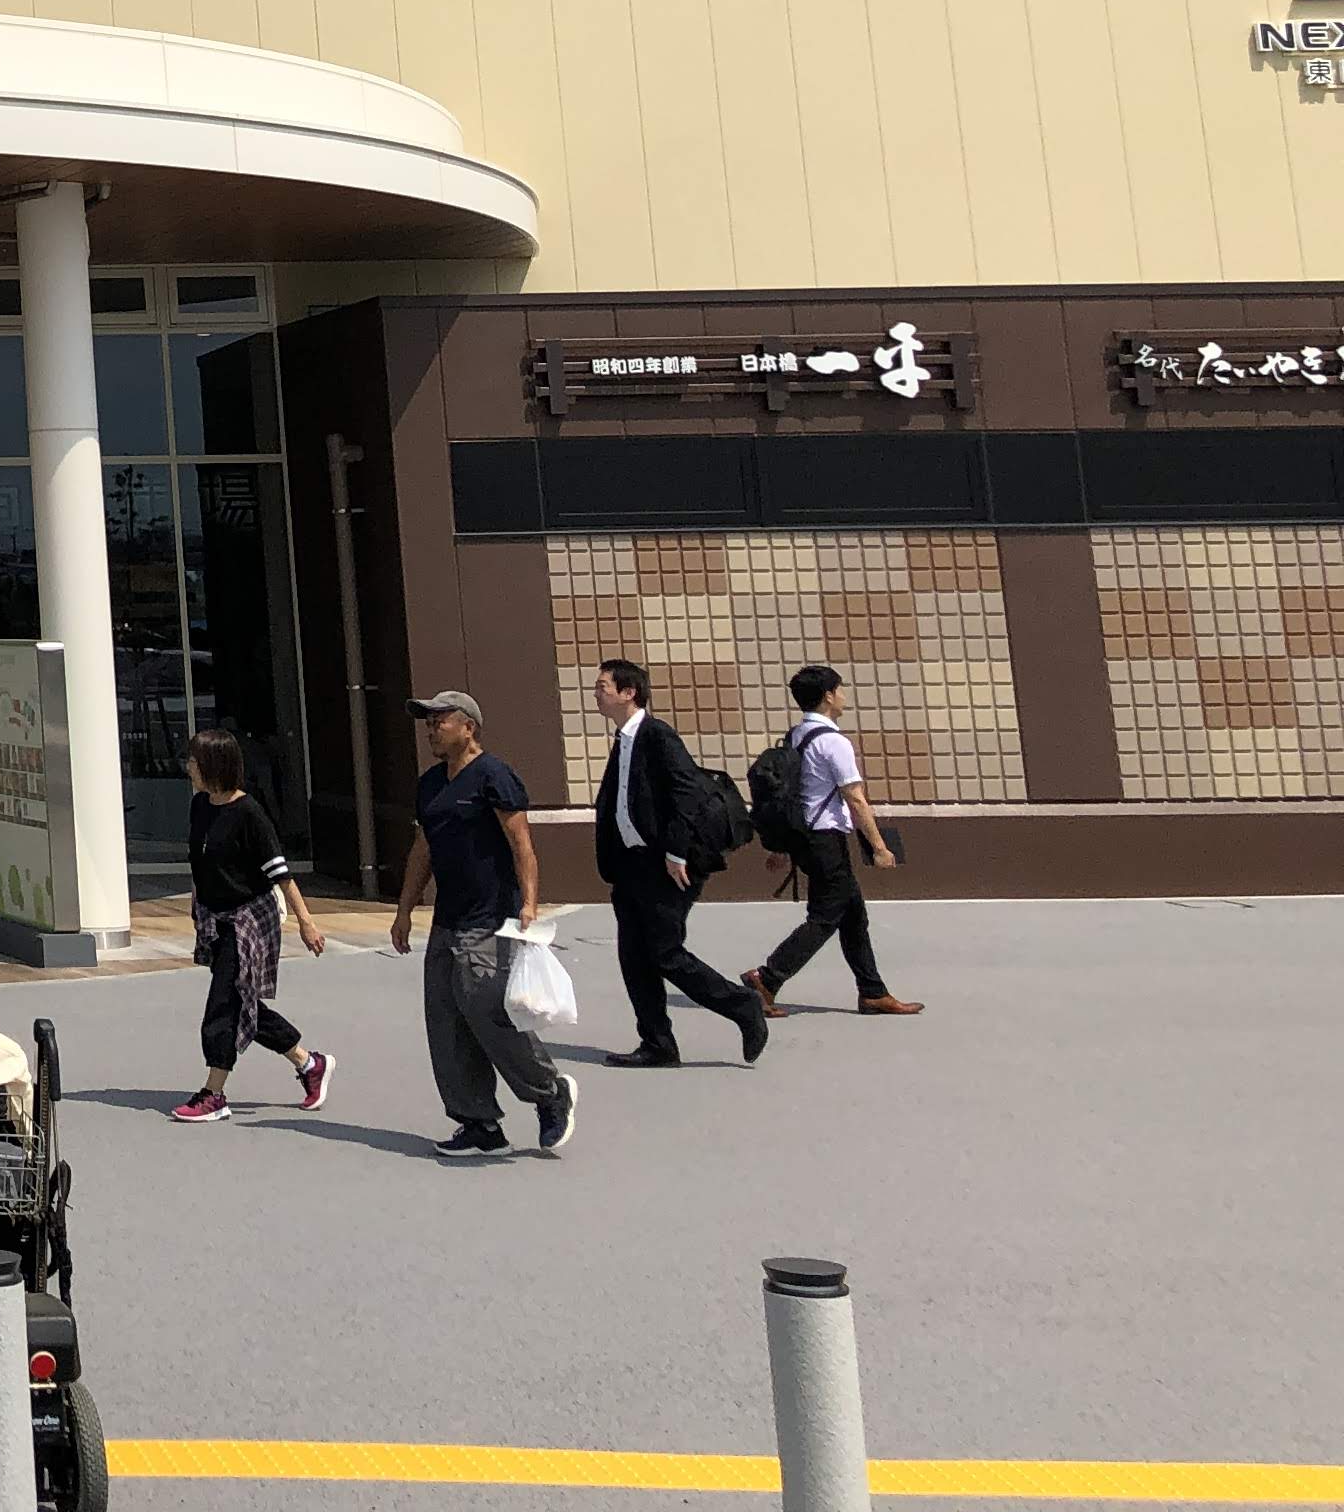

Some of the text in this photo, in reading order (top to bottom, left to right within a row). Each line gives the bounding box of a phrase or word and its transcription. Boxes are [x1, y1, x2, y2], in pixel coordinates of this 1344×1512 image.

[1306, 59, 1344, 85] 東
[591, 355, 698, 376] 昭和四年創業
[740, 352, 799, 373] 日本橋
[1196, 341, 1344, 386] たいやき
